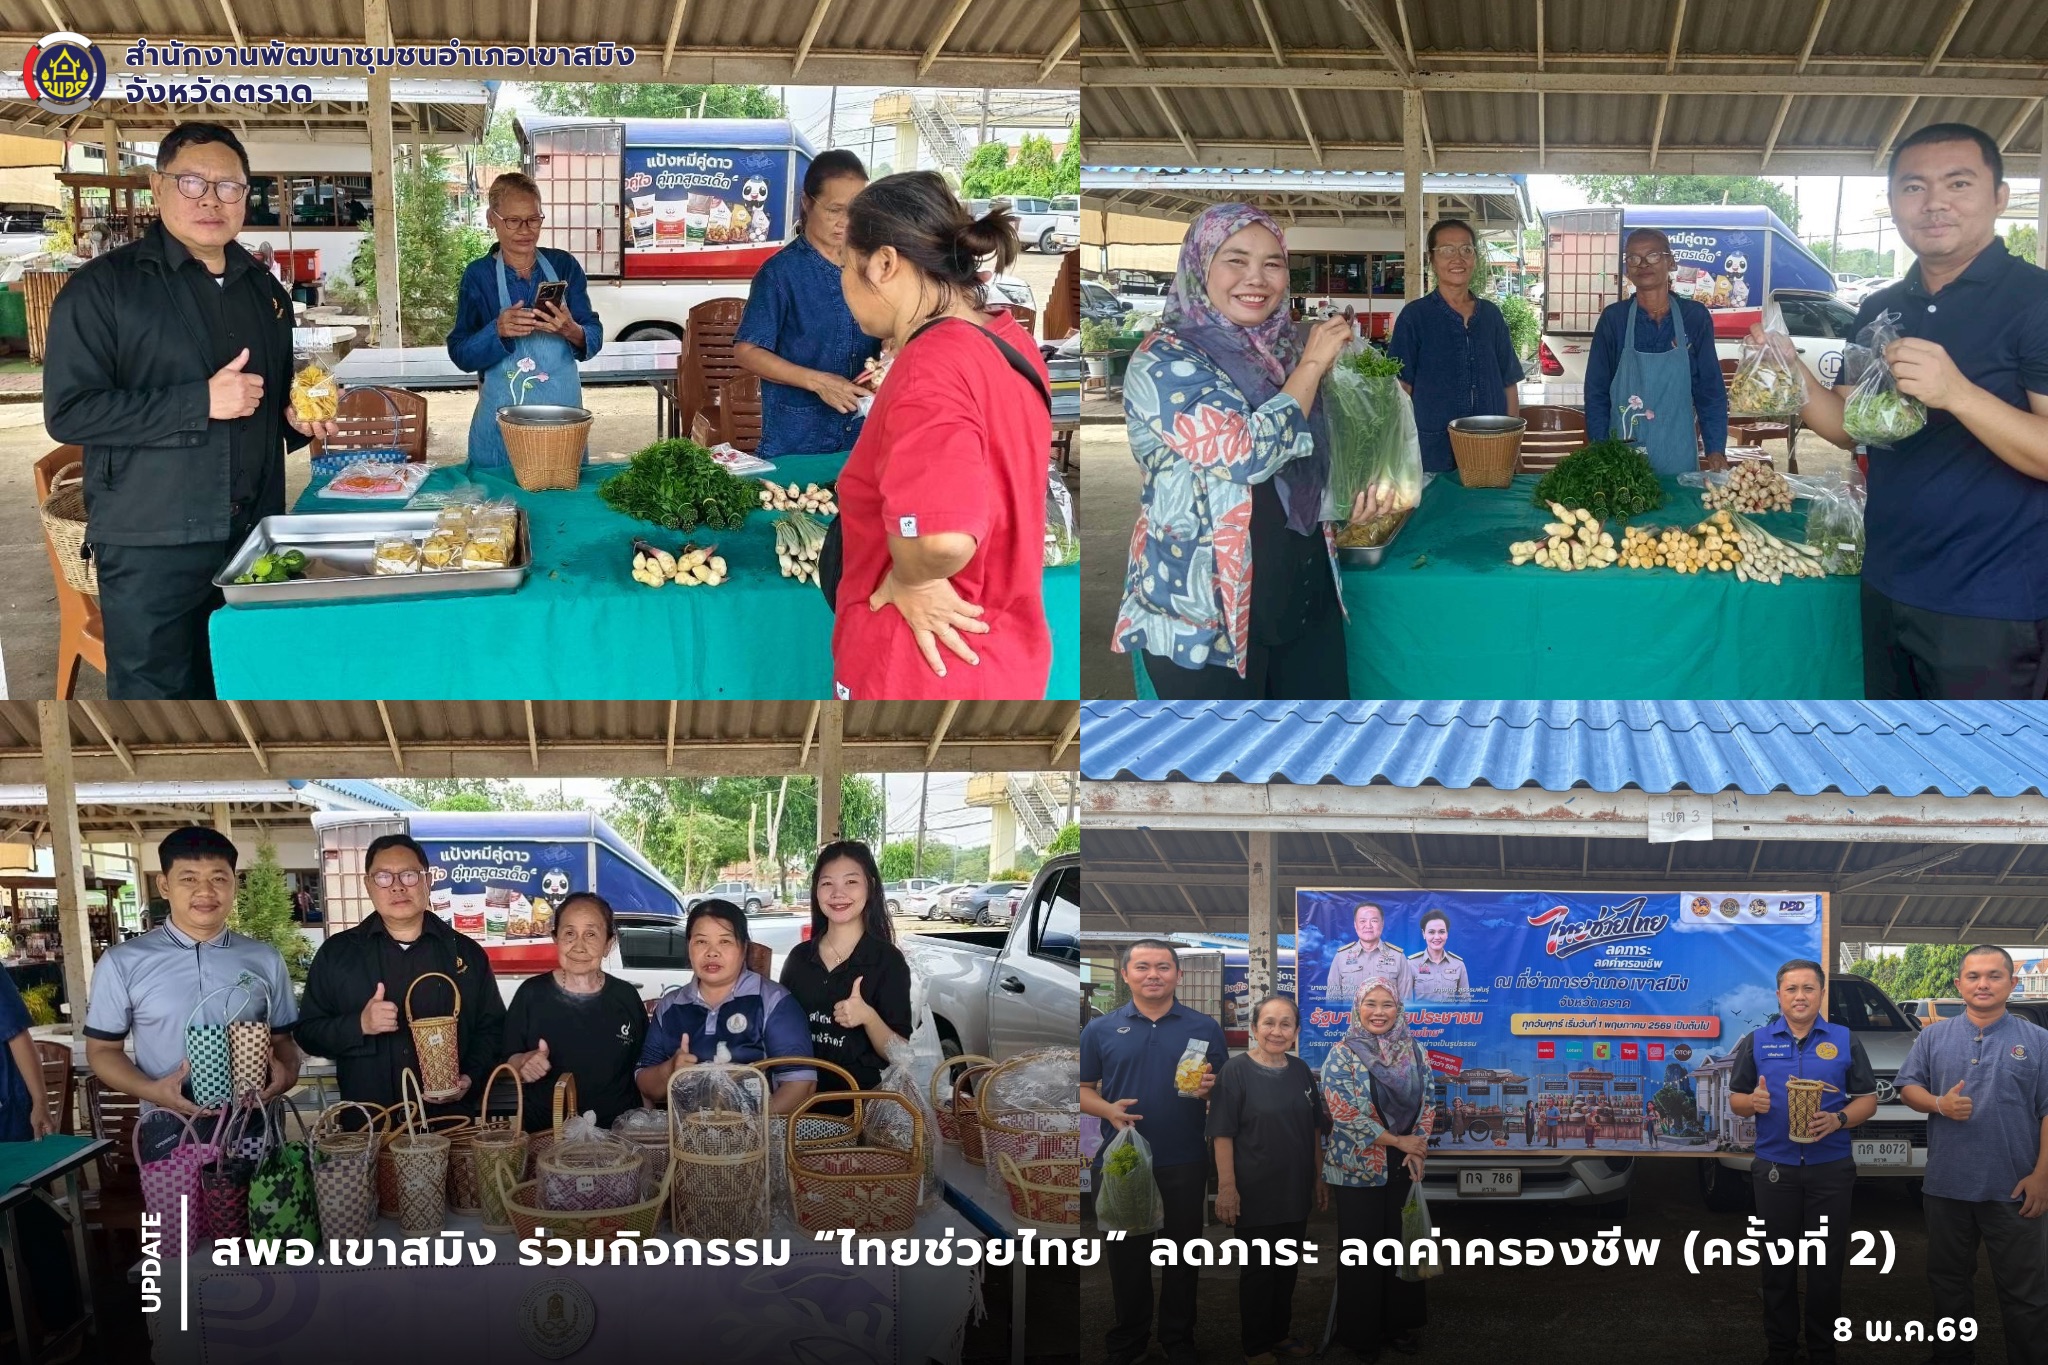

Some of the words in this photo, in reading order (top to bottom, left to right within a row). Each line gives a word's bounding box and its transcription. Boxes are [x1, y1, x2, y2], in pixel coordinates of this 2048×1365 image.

[646, 151, 733, 172] แป้งหมีคู่ดาว
[656, 170, 731, 190] คู่ทุกสูตรเด็ด
[1668, 231, 1717, 247] หมีคู่ดาว
[1661, 811, 1685, 823] เขต
[1691, 809, 1700, 823] 3
[440, 845, 531, 865] แป้งหมีคู่ดาว
[452, 864, 531, 883] คู่ทุกสูตรเด็ด
[1779, 900, 1806, 912] DBD
[1527, 896, 1670, 956] ไทยช่วยไทย
[1605, 944, 1652, 957] ลดภาระ
[1593, 957, 1664, 970] ลดค่าครองชีพ
[1495, 975, 1513, 989] ณ
[1600, 997, 1632, 1009] ตราด
[1309, 1007, 1352, 1028] รัฐบา
[1404, 1008, 1484, 1025] ยประชาชน
[1521, 1018, 1564, 1030] ทุกวันศุกร์
[1565, 1016, 1597, 1029] เริ่มวันที่
[1598, 1020, 1603, 1029] 1
[1604, 1020, 1646, 1031] พฤษภาคม
[1647, 1020, 1672, 1030] 2569
[1673, 1019, 1710, 1031] เป็นต้นไป
[1879, 1143, 1906, 1155] 8072
[1465, 1172, 1483, 1184] กจ
[1492, 1172, 1513, 1184] 786
